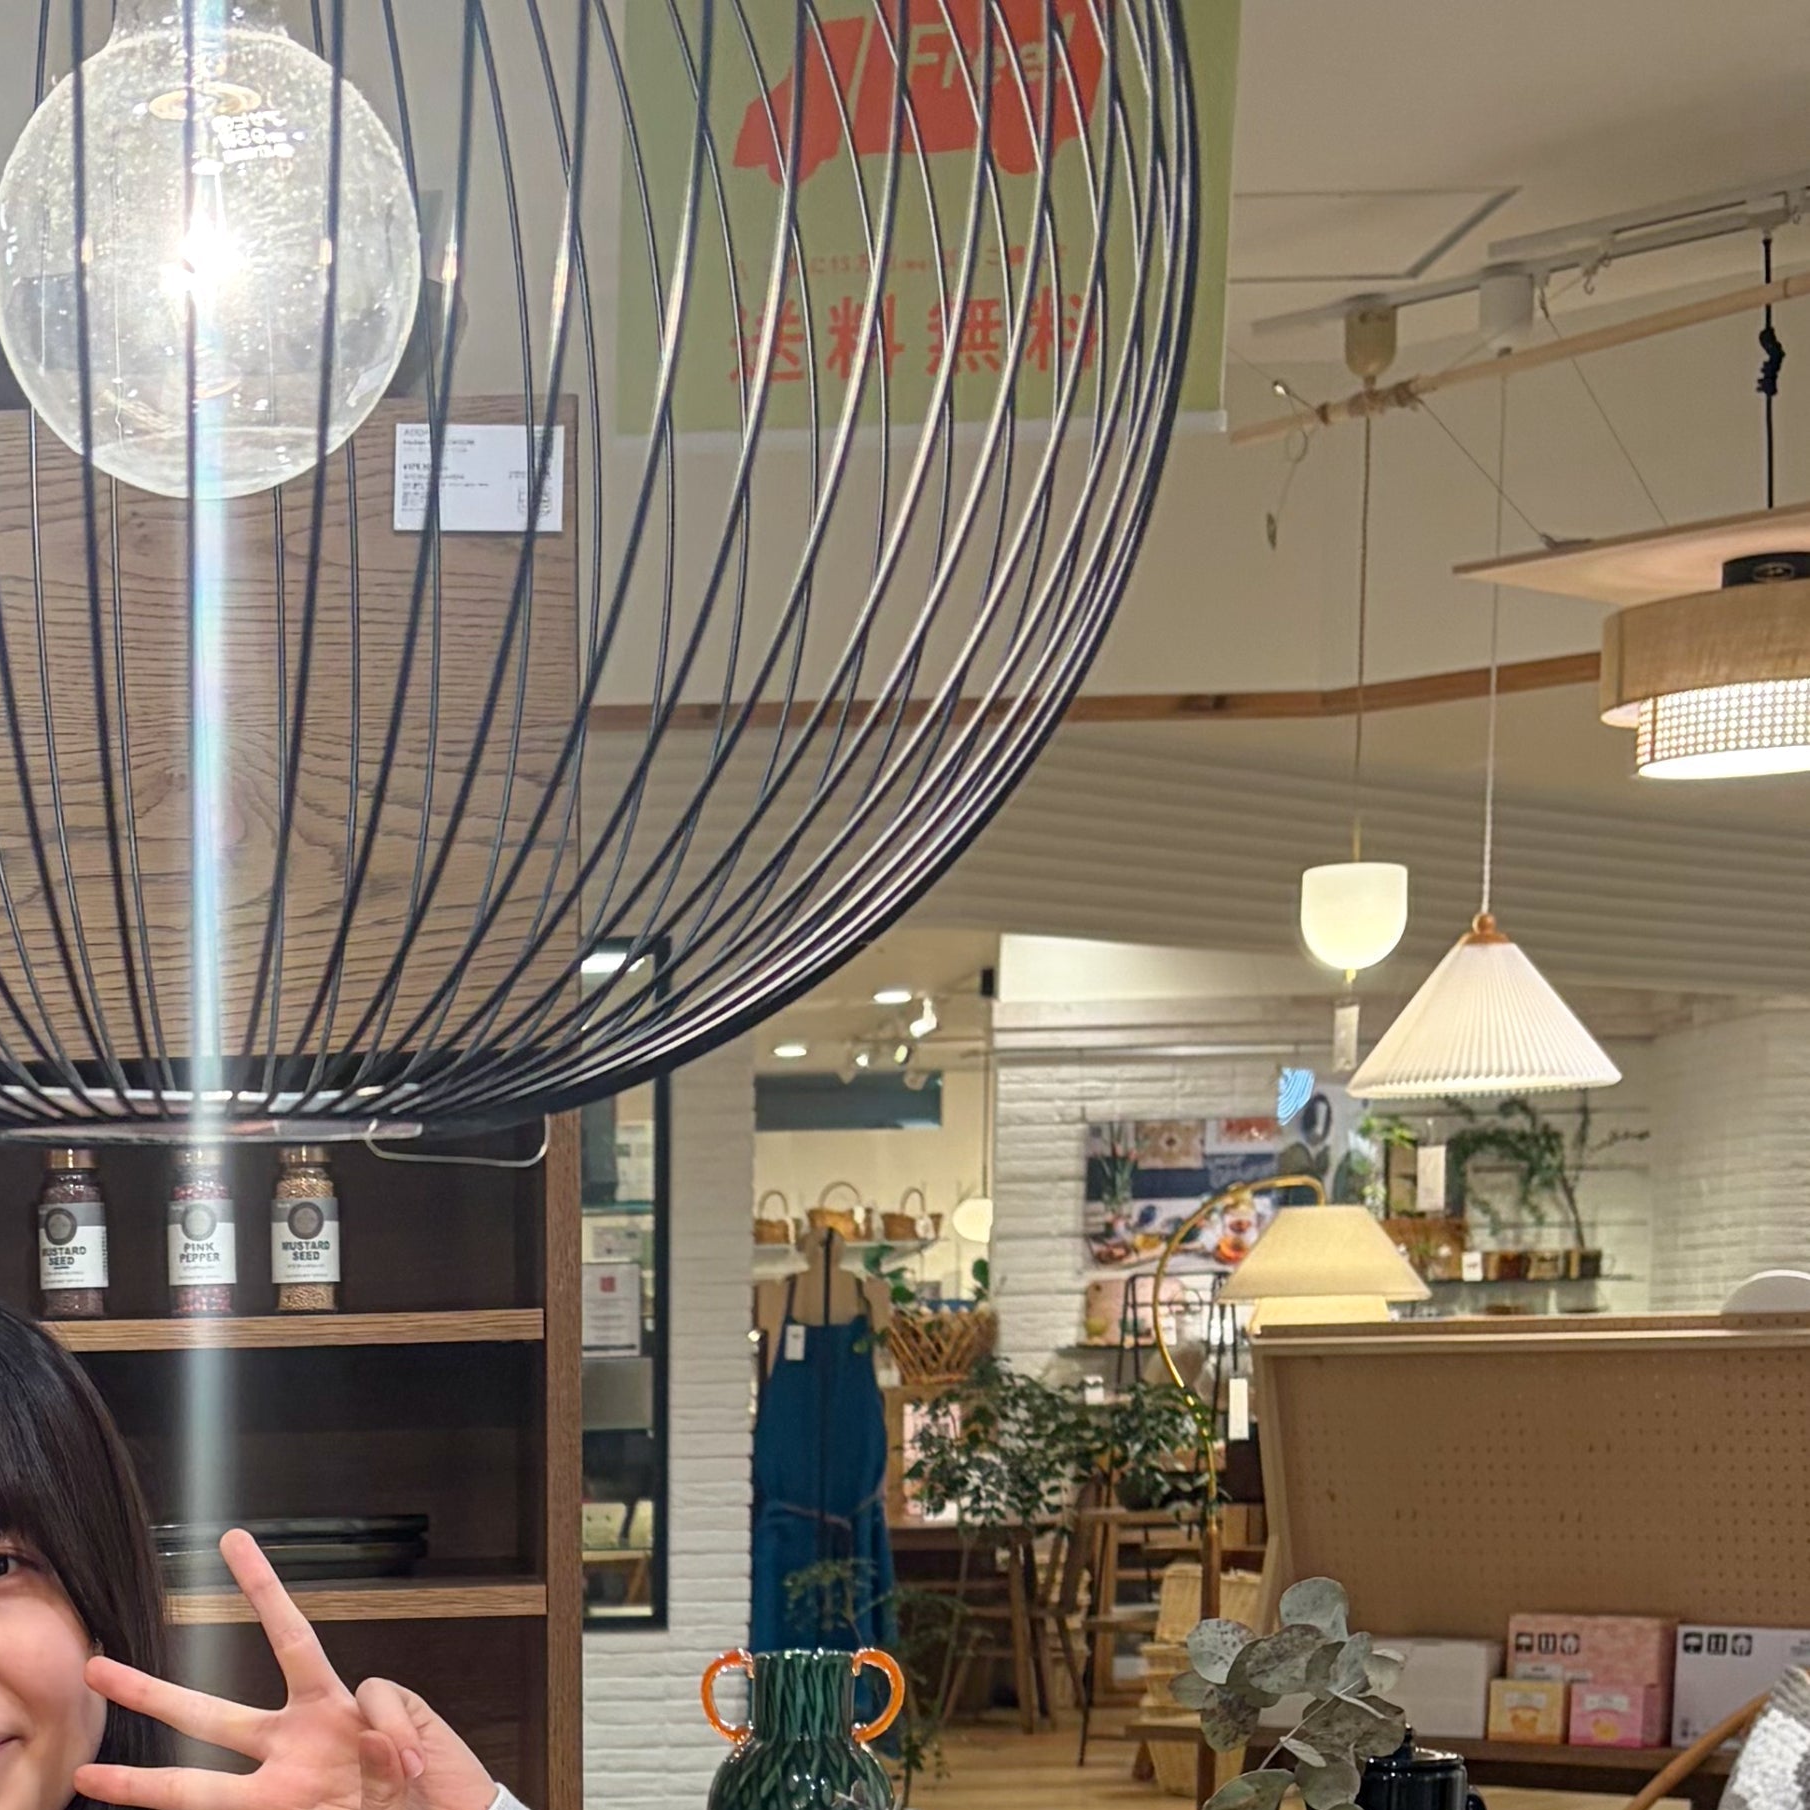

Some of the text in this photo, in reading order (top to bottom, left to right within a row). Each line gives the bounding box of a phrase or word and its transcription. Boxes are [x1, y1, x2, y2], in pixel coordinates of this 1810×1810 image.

[728, 285, 1099, 383] 送料無料
[183, 1242, 215, 1253] PINK
[282, 1240, 330, 1251] MUSTARD
[48, 1256, 75, 1266] SEED
[179, 1252, 220, 1263] PEPPER
[292, 1251, 320, 1261] SEED
